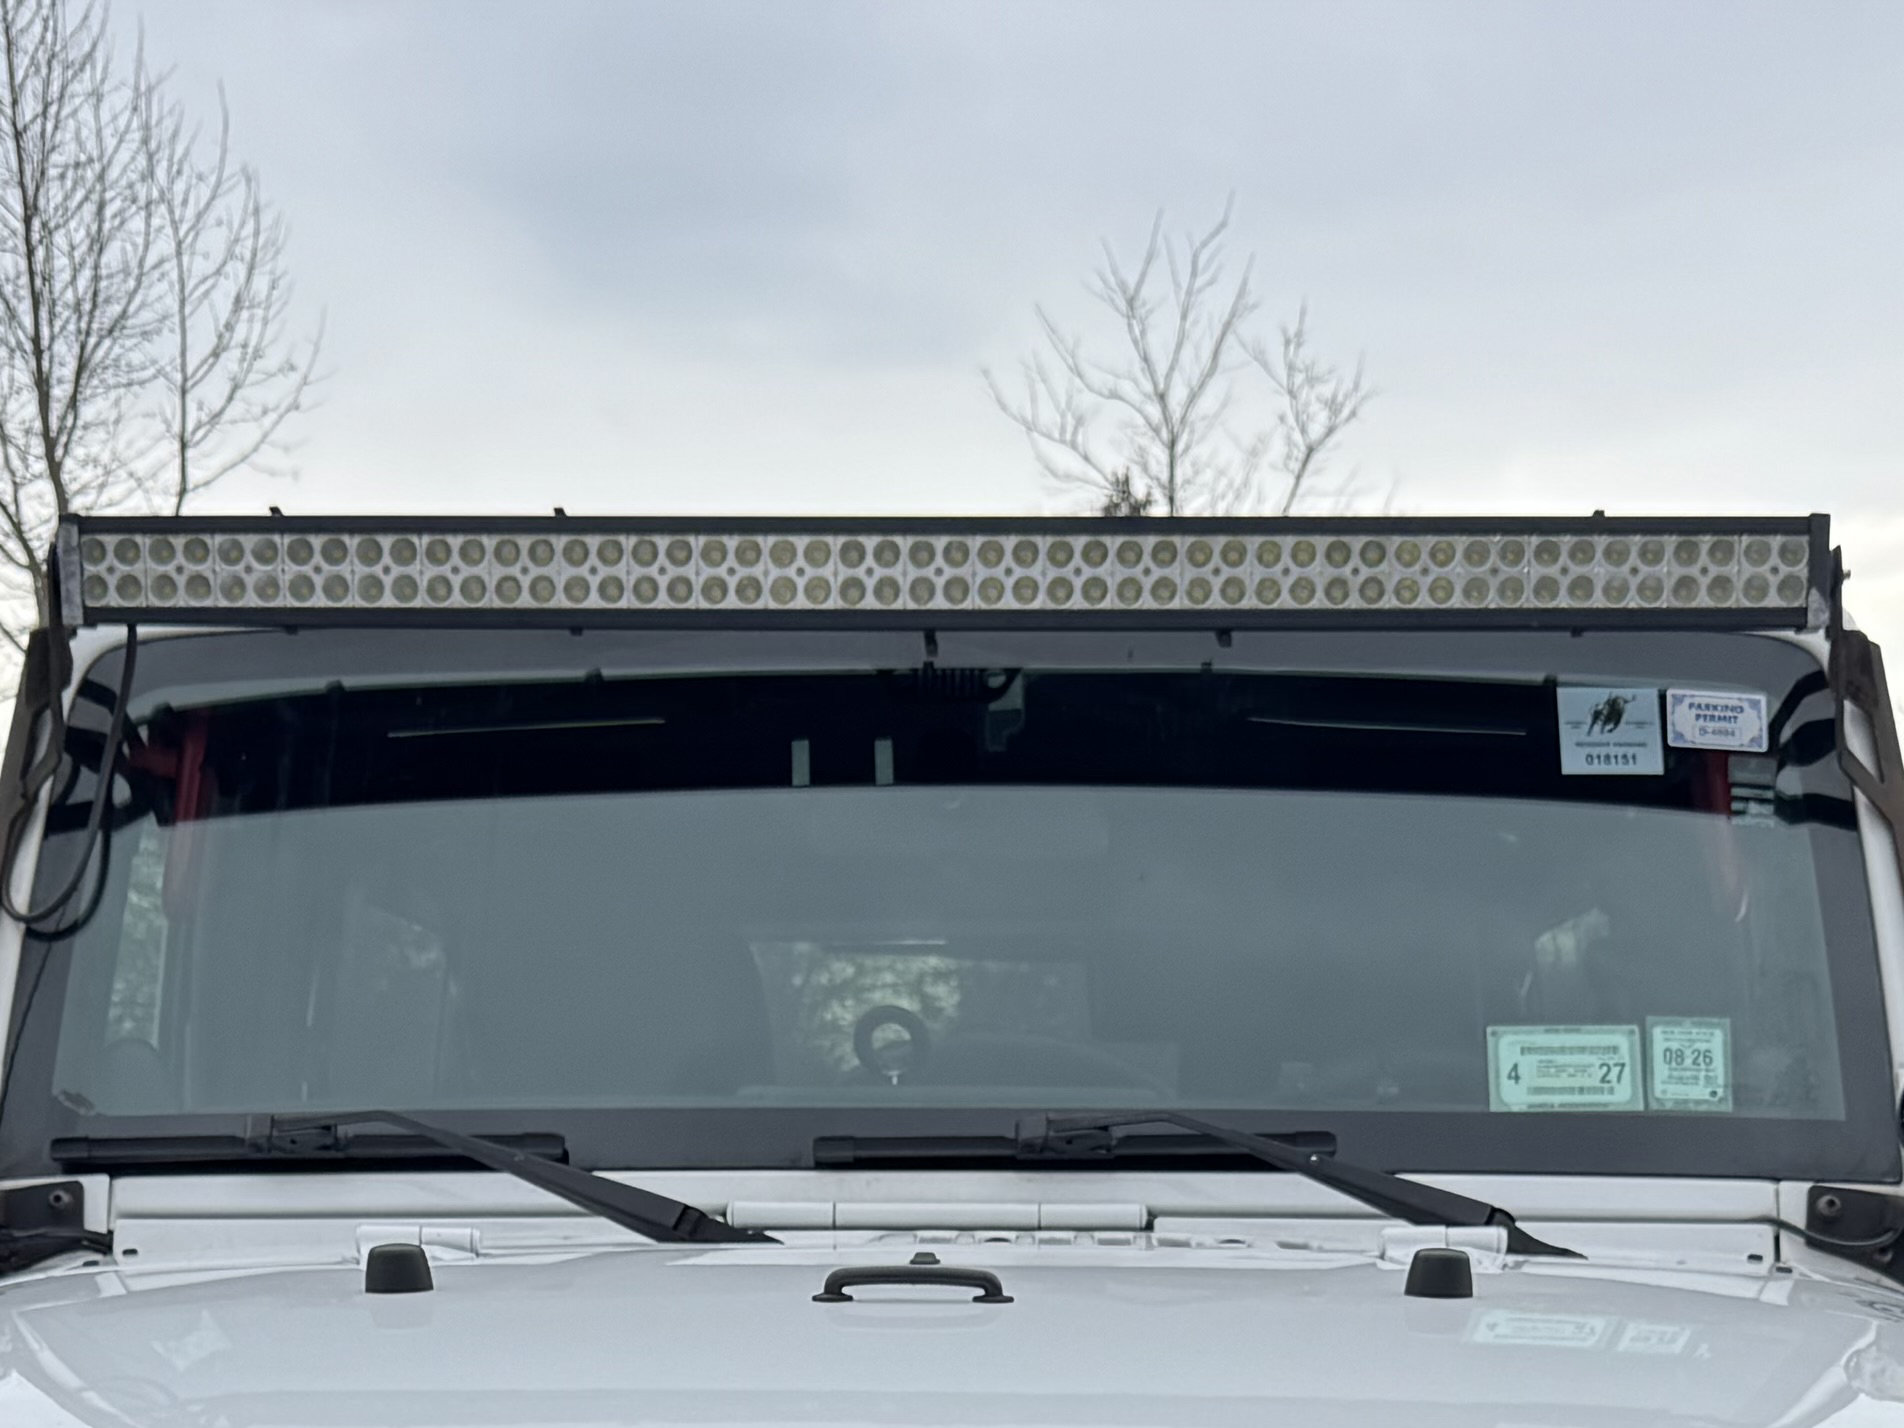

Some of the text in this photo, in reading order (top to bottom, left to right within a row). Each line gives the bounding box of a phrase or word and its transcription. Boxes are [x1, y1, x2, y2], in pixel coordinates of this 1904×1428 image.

[1688, 702, 1745, 714] PARKING
[1695, 714, 1739, 724] PERMIT
[1507, 1062, 1521, 1085] 4
[1598, 1062, 1626, 1085] 27
